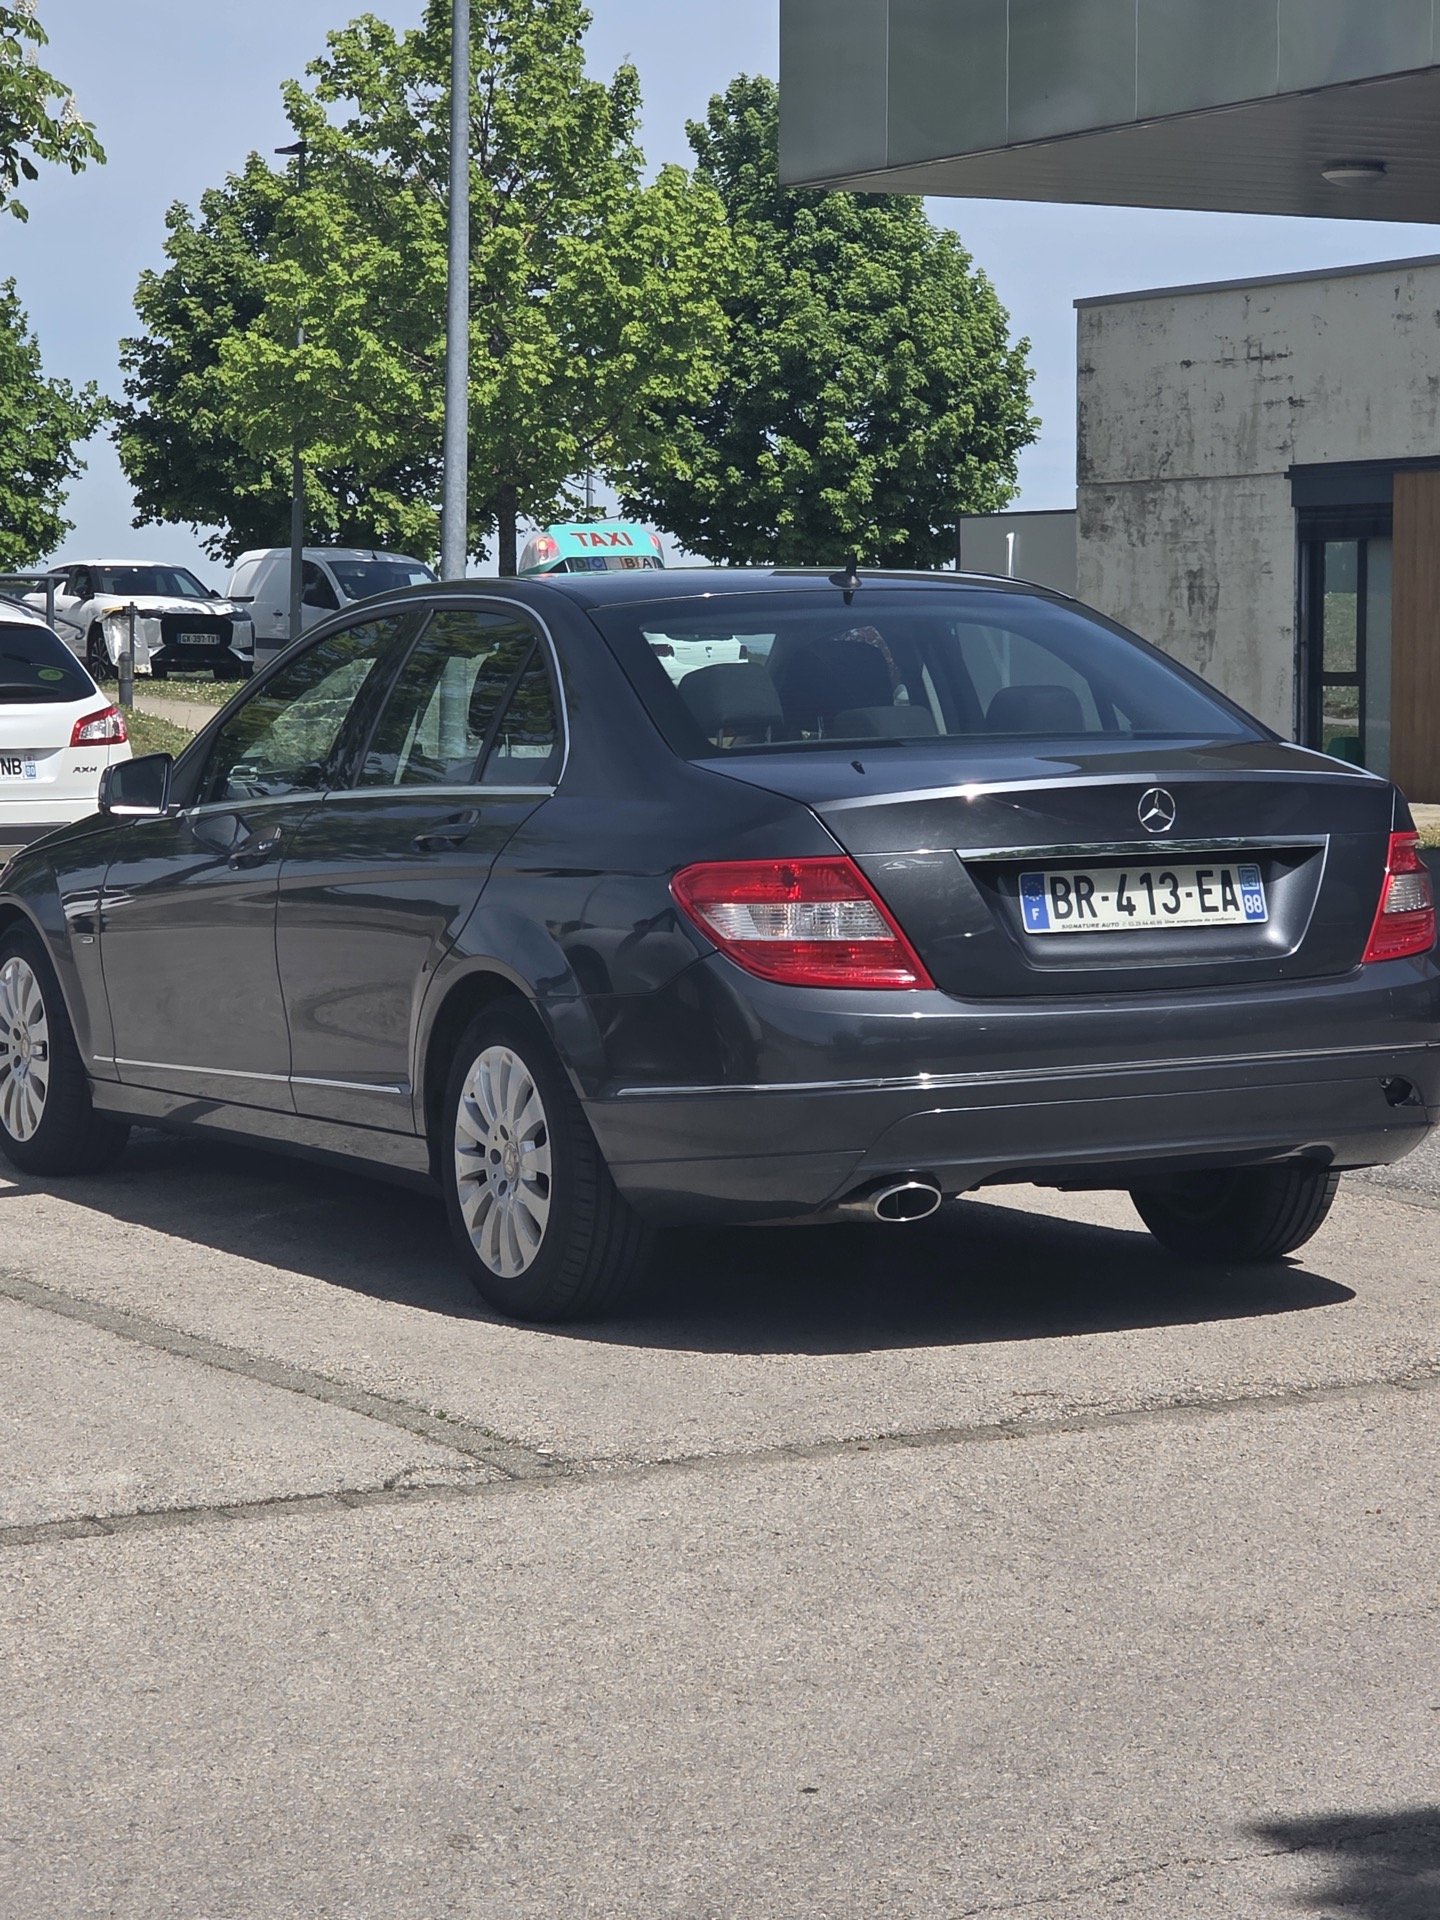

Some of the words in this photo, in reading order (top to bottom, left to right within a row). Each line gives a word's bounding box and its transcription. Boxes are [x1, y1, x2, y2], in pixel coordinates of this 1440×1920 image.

[570, 532, 634, 547] TAXI
[625, 557, 635, 568] B
[642, 558, 653, 569] A
[1050, 870, 1240, 919] BR-413-EA
[1244, 894, 1263, 913] 88
[1031, 907, 1040, 921] F
[1061, 922, 1100, 930] SIGNATURE
